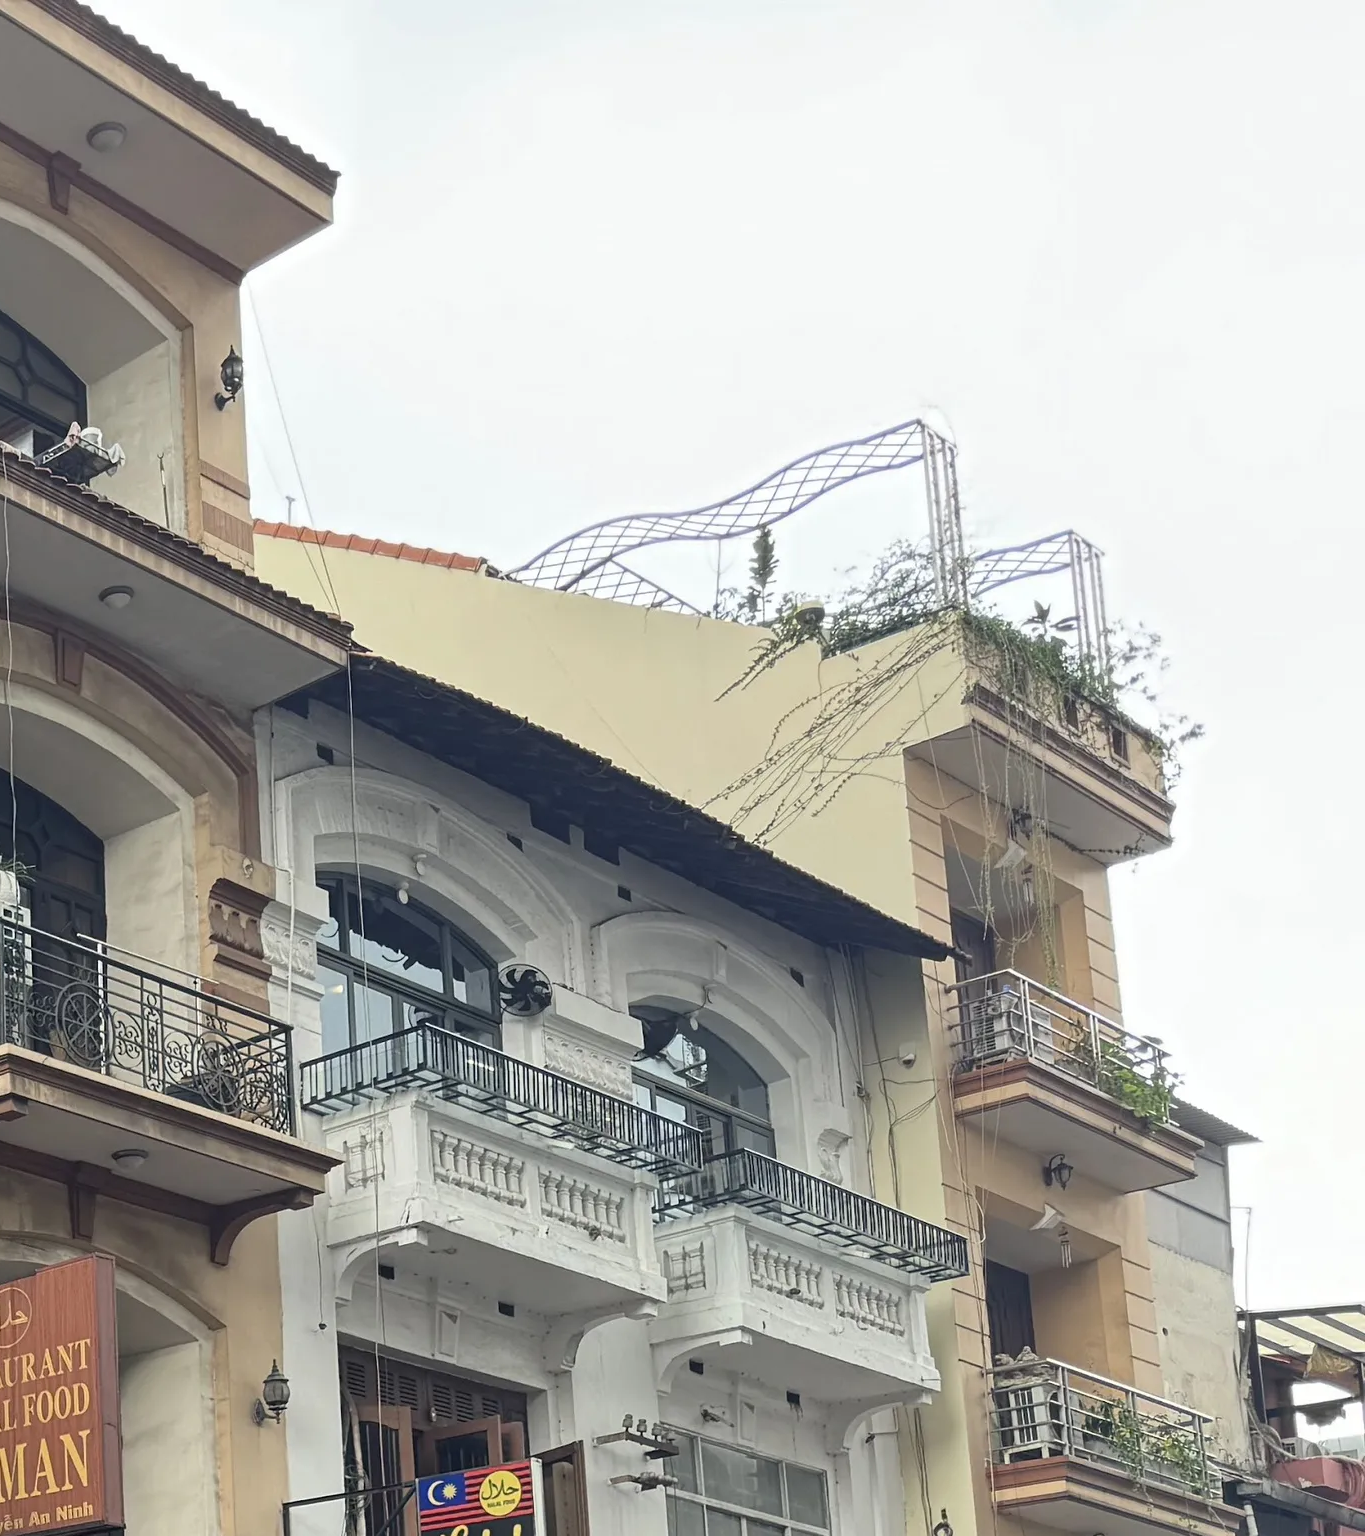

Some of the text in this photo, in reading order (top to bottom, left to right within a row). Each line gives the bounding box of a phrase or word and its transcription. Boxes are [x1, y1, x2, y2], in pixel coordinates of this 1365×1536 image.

[23, 1382, 90, 1427] FOOD
[481, 1478, 519, 1500] حلال
[29, 1511, 50, 1527] An
[56, 1501, 93, 1522] Ninh
